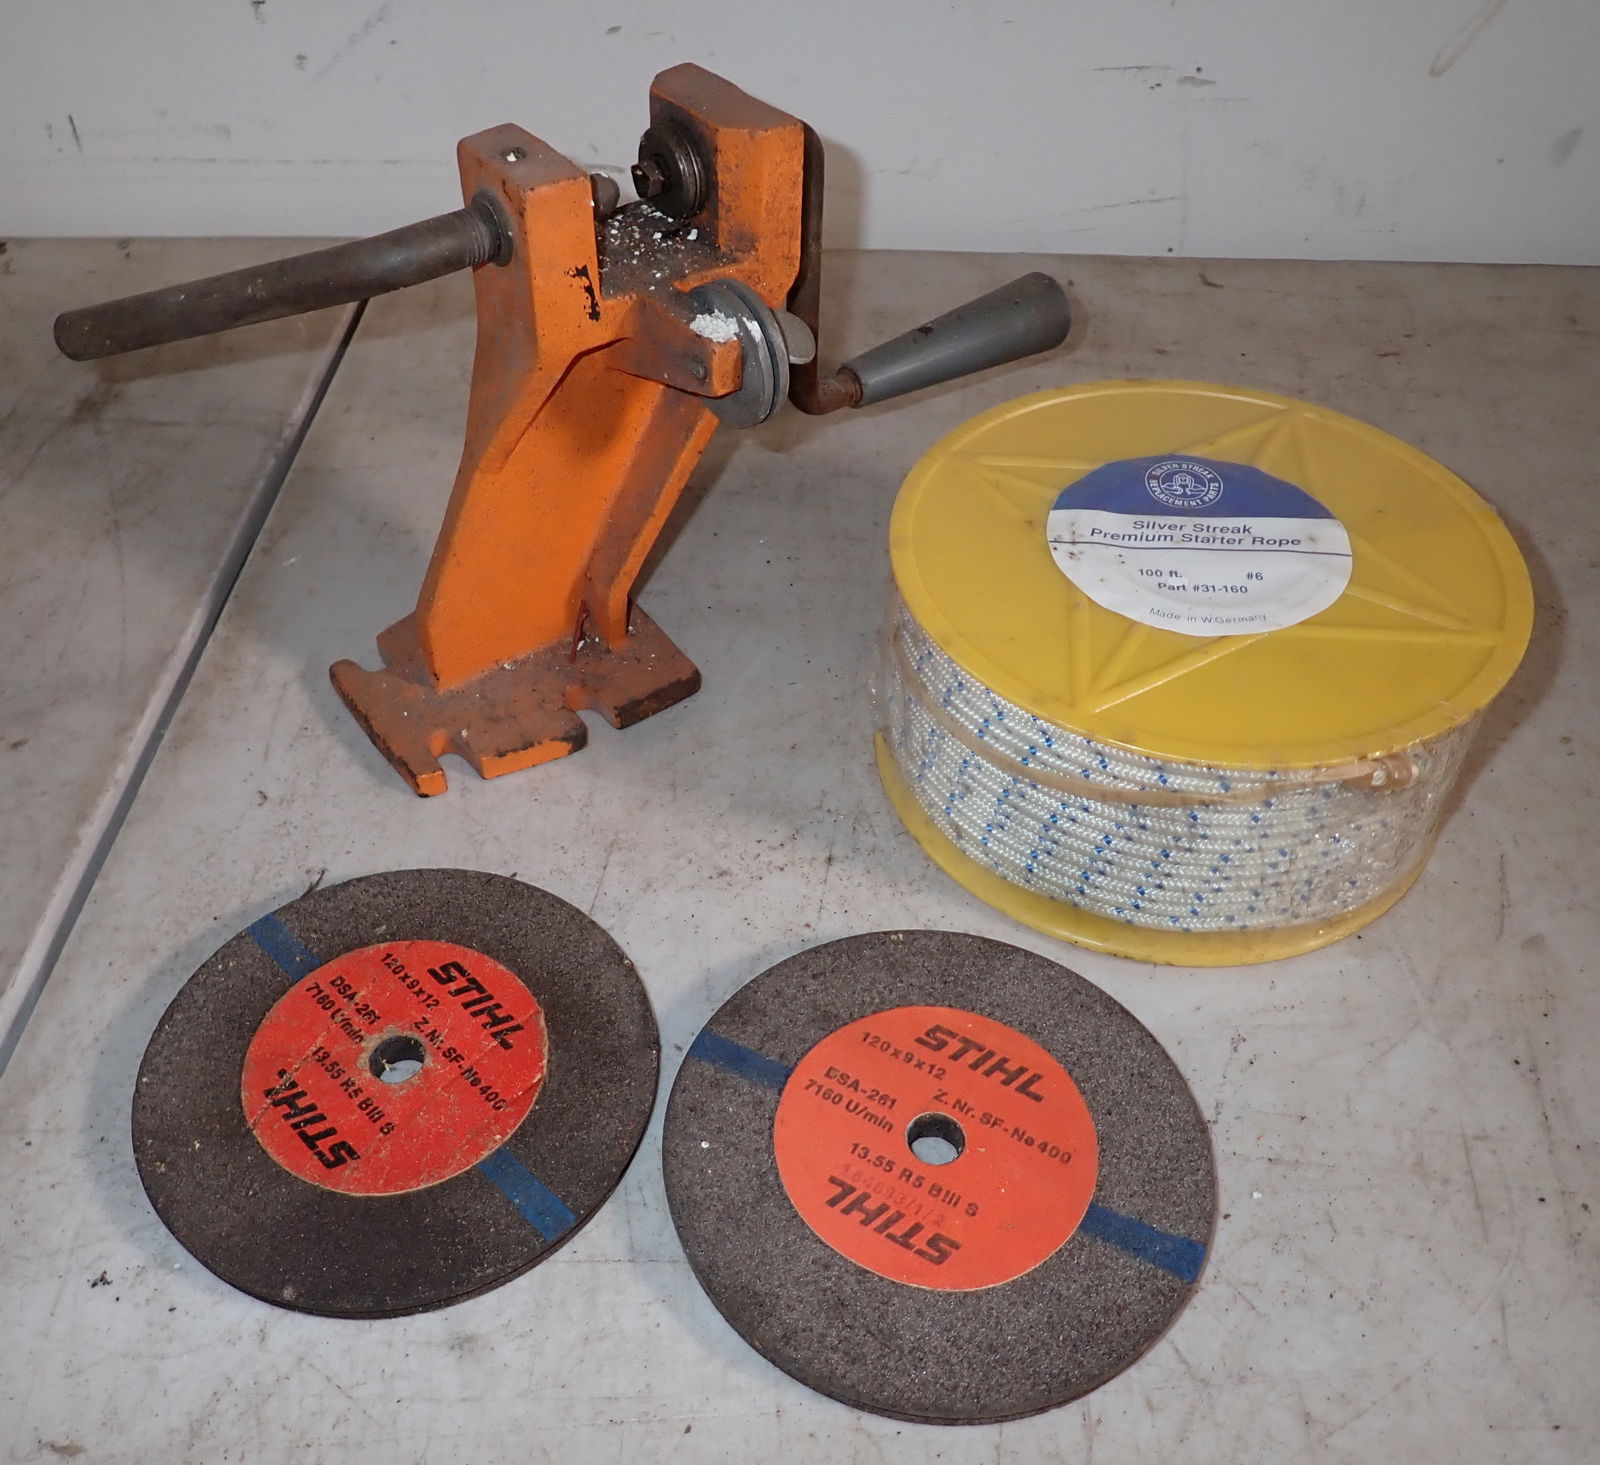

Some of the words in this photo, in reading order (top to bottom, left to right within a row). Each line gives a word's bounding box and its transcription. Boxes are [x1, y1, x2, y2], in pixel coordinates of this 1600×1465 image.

[1203, 482, 1220, 503] PARTS
[1090, 527, 1174, 542] Premium
[1181, 533, 1245, 546] Starter
[1252, 536, 1302, 547] Rope
[1132, 520, 1187, 532] Silver
[1193, 523, 1253, 535] Streak
[1138, 568, 1163, 578] 100
[1246, 571, 1264, 581] #6
[1158, 582, 1187, 592] Part
[1193, 584, 1249, 594] #31-160
[1149, 607, 1181, 620] Made
[1187, 614, 1197, 623] in
[305, 981, 335, 1014] 7160
[427, 960, 525, 1051] STIHL
[311, 1045, 349, 1082] 13.55
[341, 1077, 364, 1101] R5
[914, 1023, 1048, 1104] STIHL
[804, 1078, 842, 1107] 7160
[845, 1099, 895, 1134] U/min
[824, 1065, 898, 1110] DSA-261
[263, 1067, 362, 1170] STIHL
[953, 1098, 976, 1119] Nr.
[850, 1142, 894, 1175] 13.55
[898, 1167, 924, 1190] R5
[964, 1201, 980, 1218] S
[825, 1174, 962, 1267] STIHL
